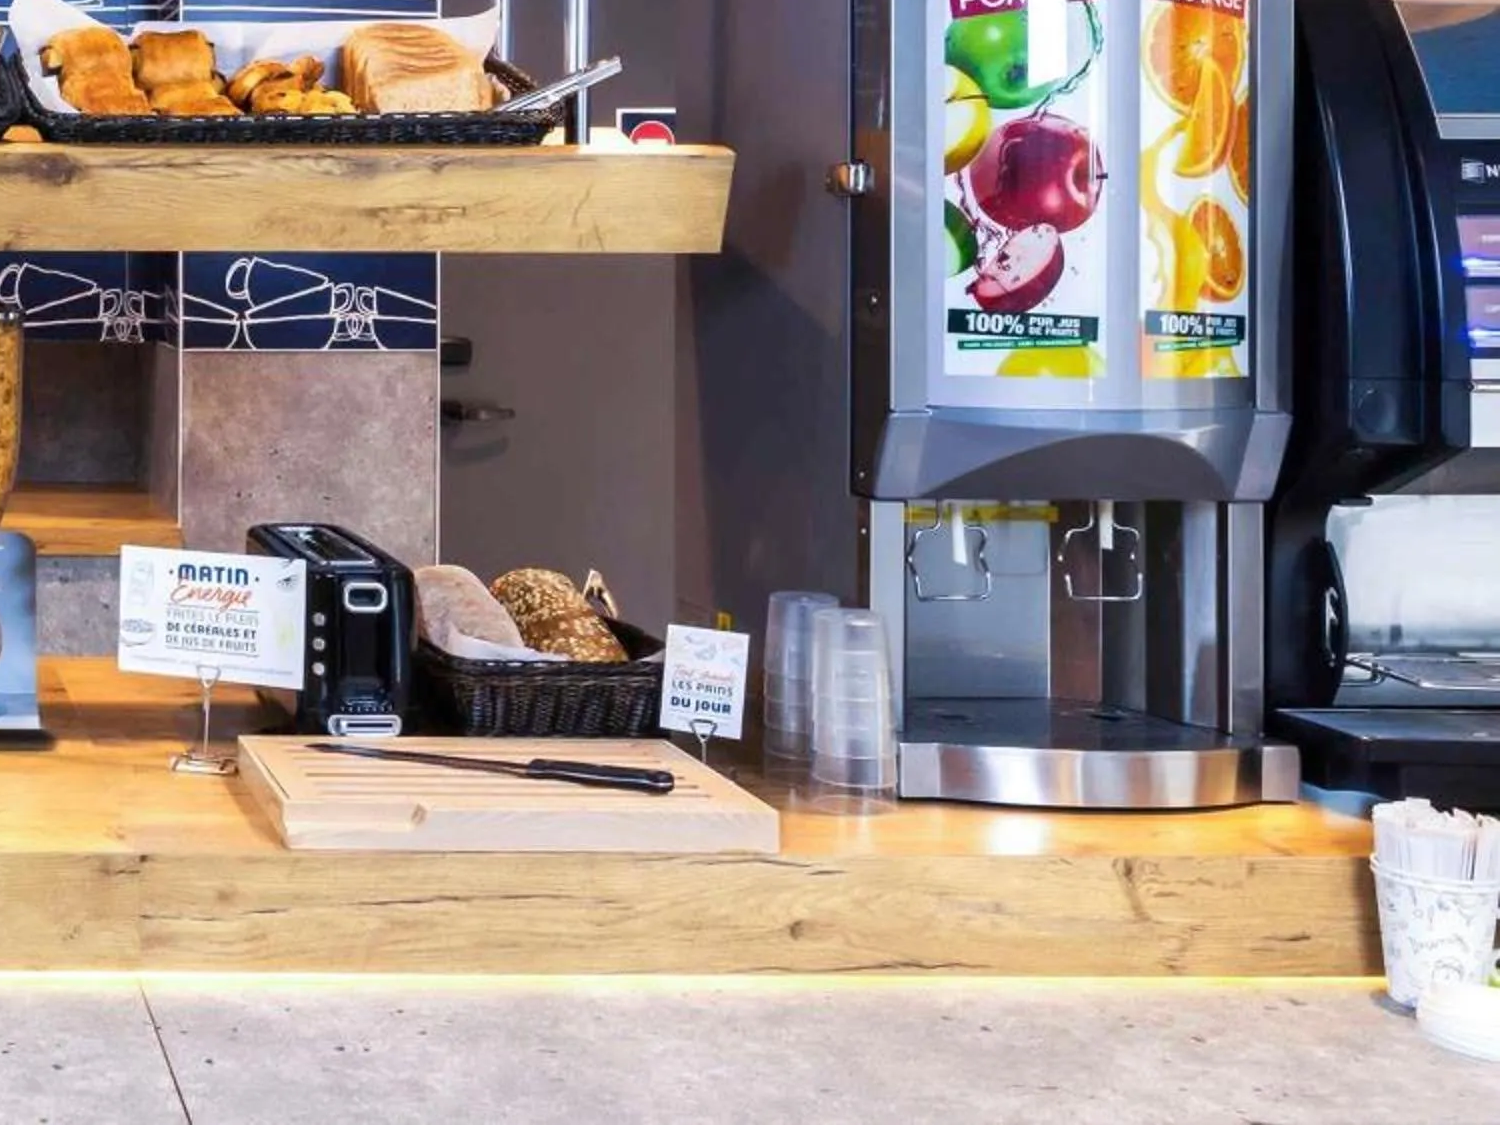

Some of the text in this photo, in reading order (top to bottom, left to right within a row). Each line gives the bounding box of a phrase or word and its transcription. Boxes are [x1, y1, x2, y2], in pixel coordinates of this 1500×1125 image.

[964, 312, 1081, 335] 100% PUR JUS
[1159, 314, 1204, 335] 100%
[178, 563, 249, 586] MATIN
[167, 621, 180, 632] DE
[244, 628, 257, 640] ET
[671, 678, 734, 698] LES PAINS
[670, 695, 732, 714] DU JOUR
